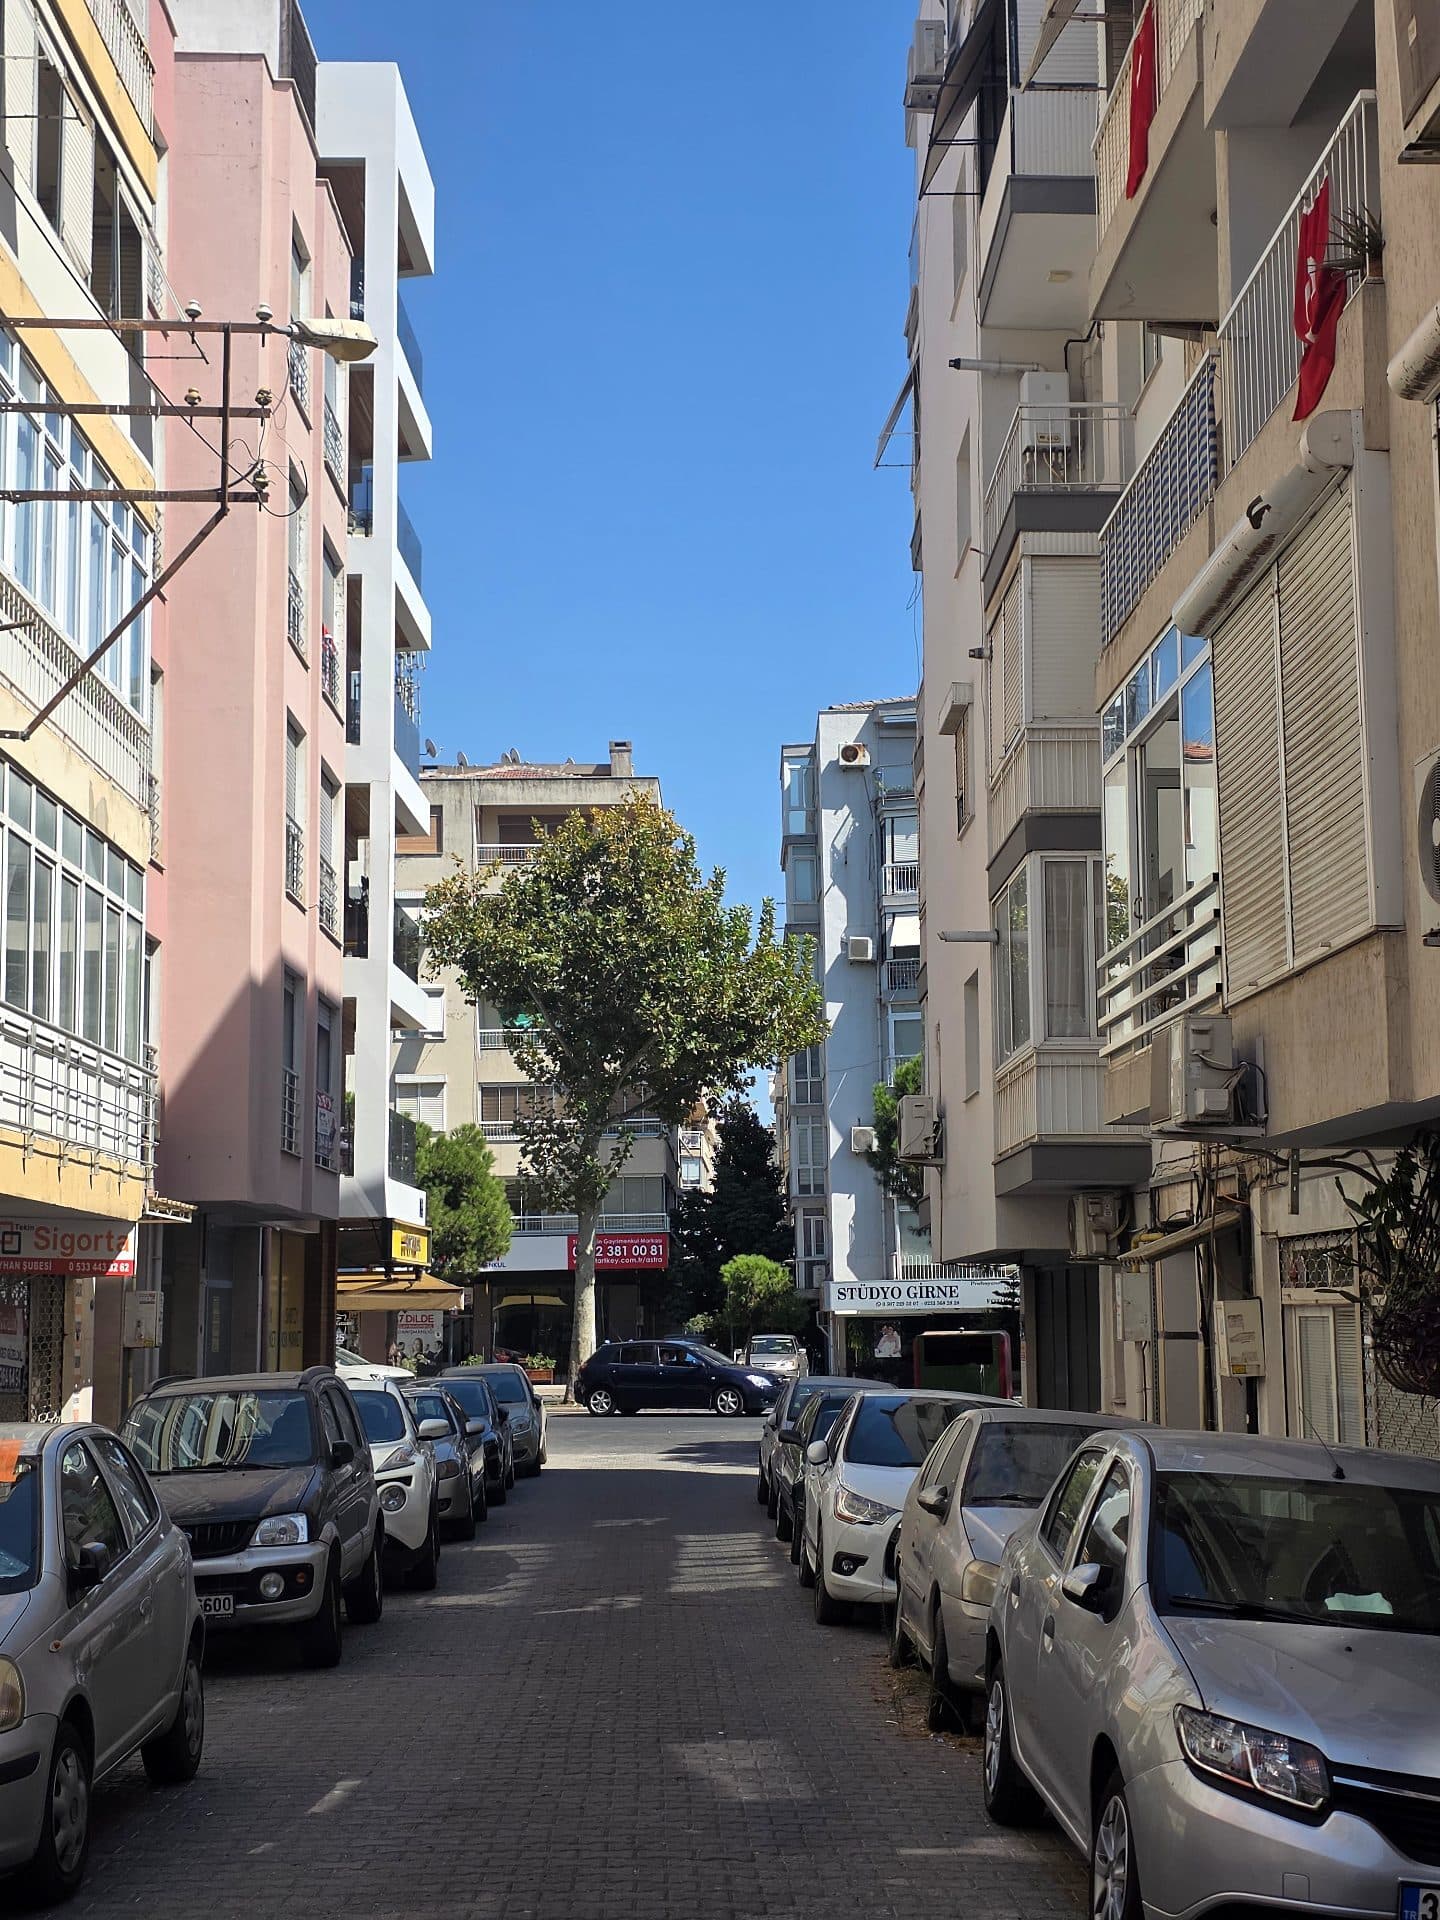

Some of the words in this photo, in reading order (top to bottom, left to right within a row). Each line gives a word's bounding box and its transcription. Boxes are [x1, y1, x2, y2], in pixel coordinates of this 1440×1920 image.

[15, 1223, 35, 1231] Tekin
[34, 1225, 129, 1257] Sigorta
[606, 1245, 627, 1256] 381
[632, 1245, 647, 1256] 00
[650, 1245, 663, 1256] 81
[22, 1260, 52, 1272] ŞUBESİ
[68, 1263, 74, 1271] 0
[76, 1263, 91, 1271] 533
[837, 1283, 902, 1300] STÜDYO
[906, 1282, 959, 1299] GİRNE
[1403, 1910, 1417, 1920] TR
